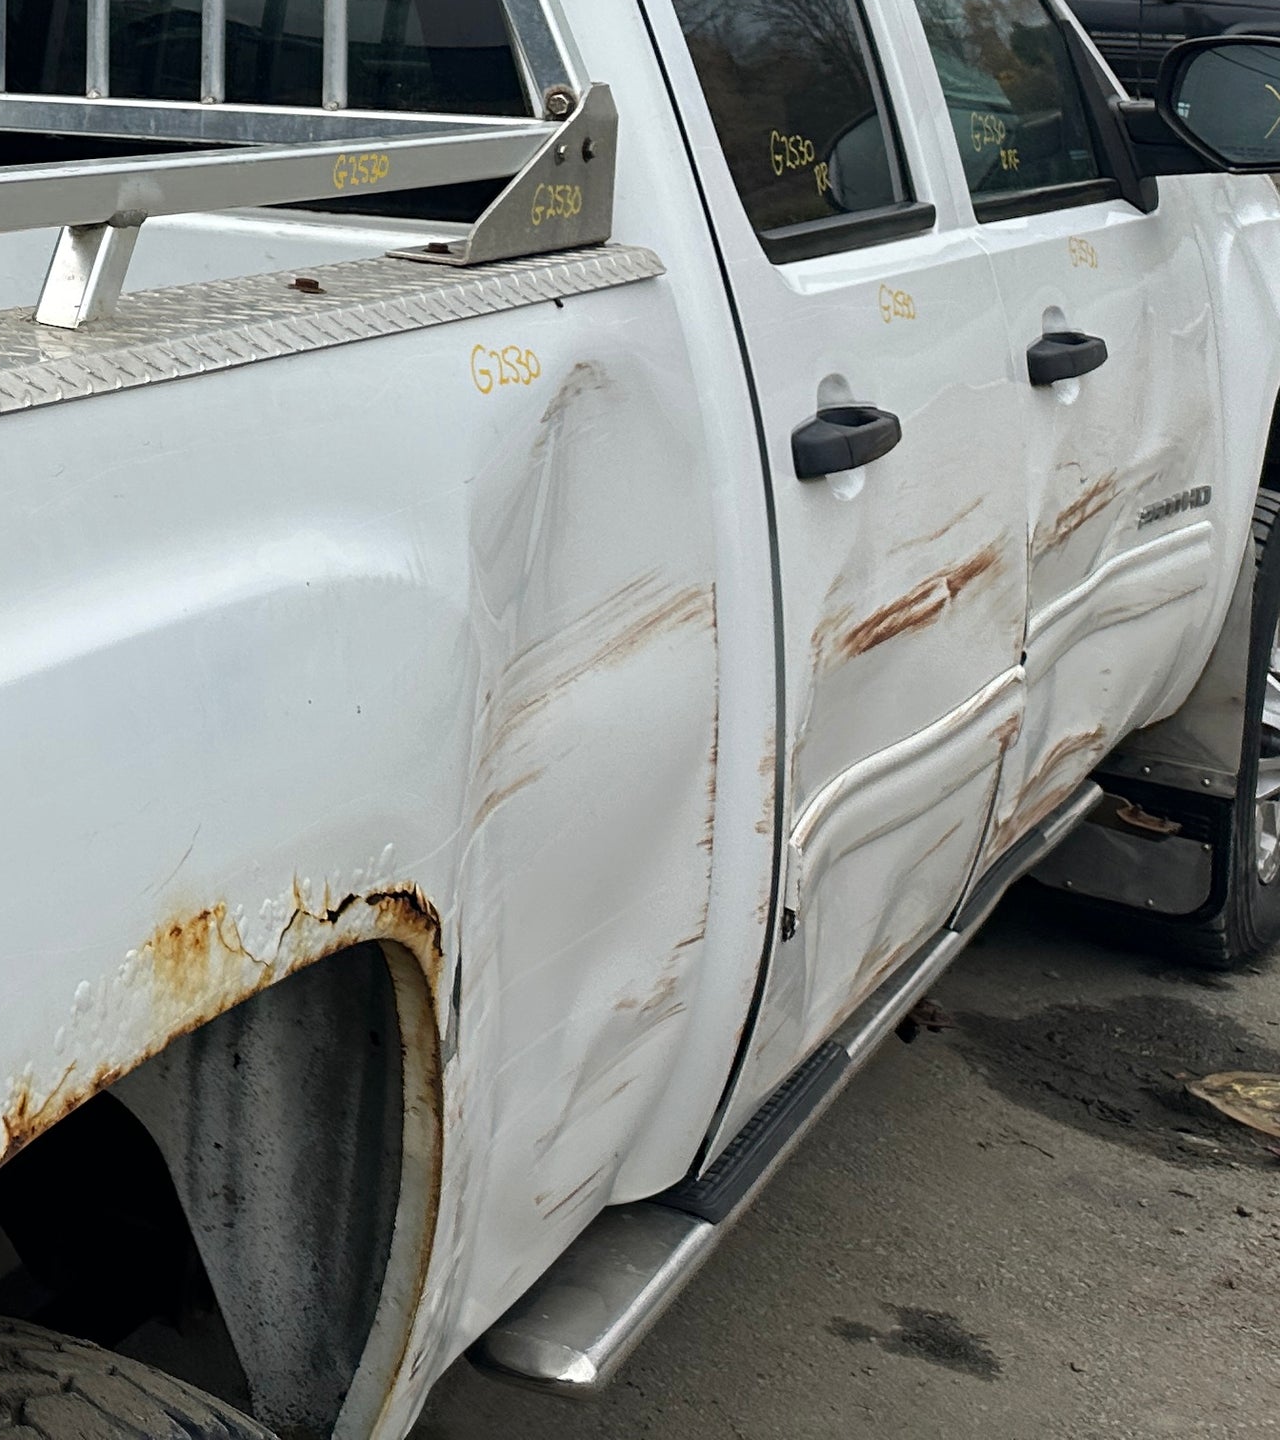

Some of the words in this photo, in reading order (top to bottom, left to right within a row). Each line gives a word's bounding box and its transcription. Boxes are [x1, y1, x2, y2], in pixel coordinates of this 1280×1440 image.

[332, 154, 390, 189] G2530
[770, 130, 815, 176] G2530
[531, 183, 582, 225] G2530
[471, 344, 540, 394] G2530
